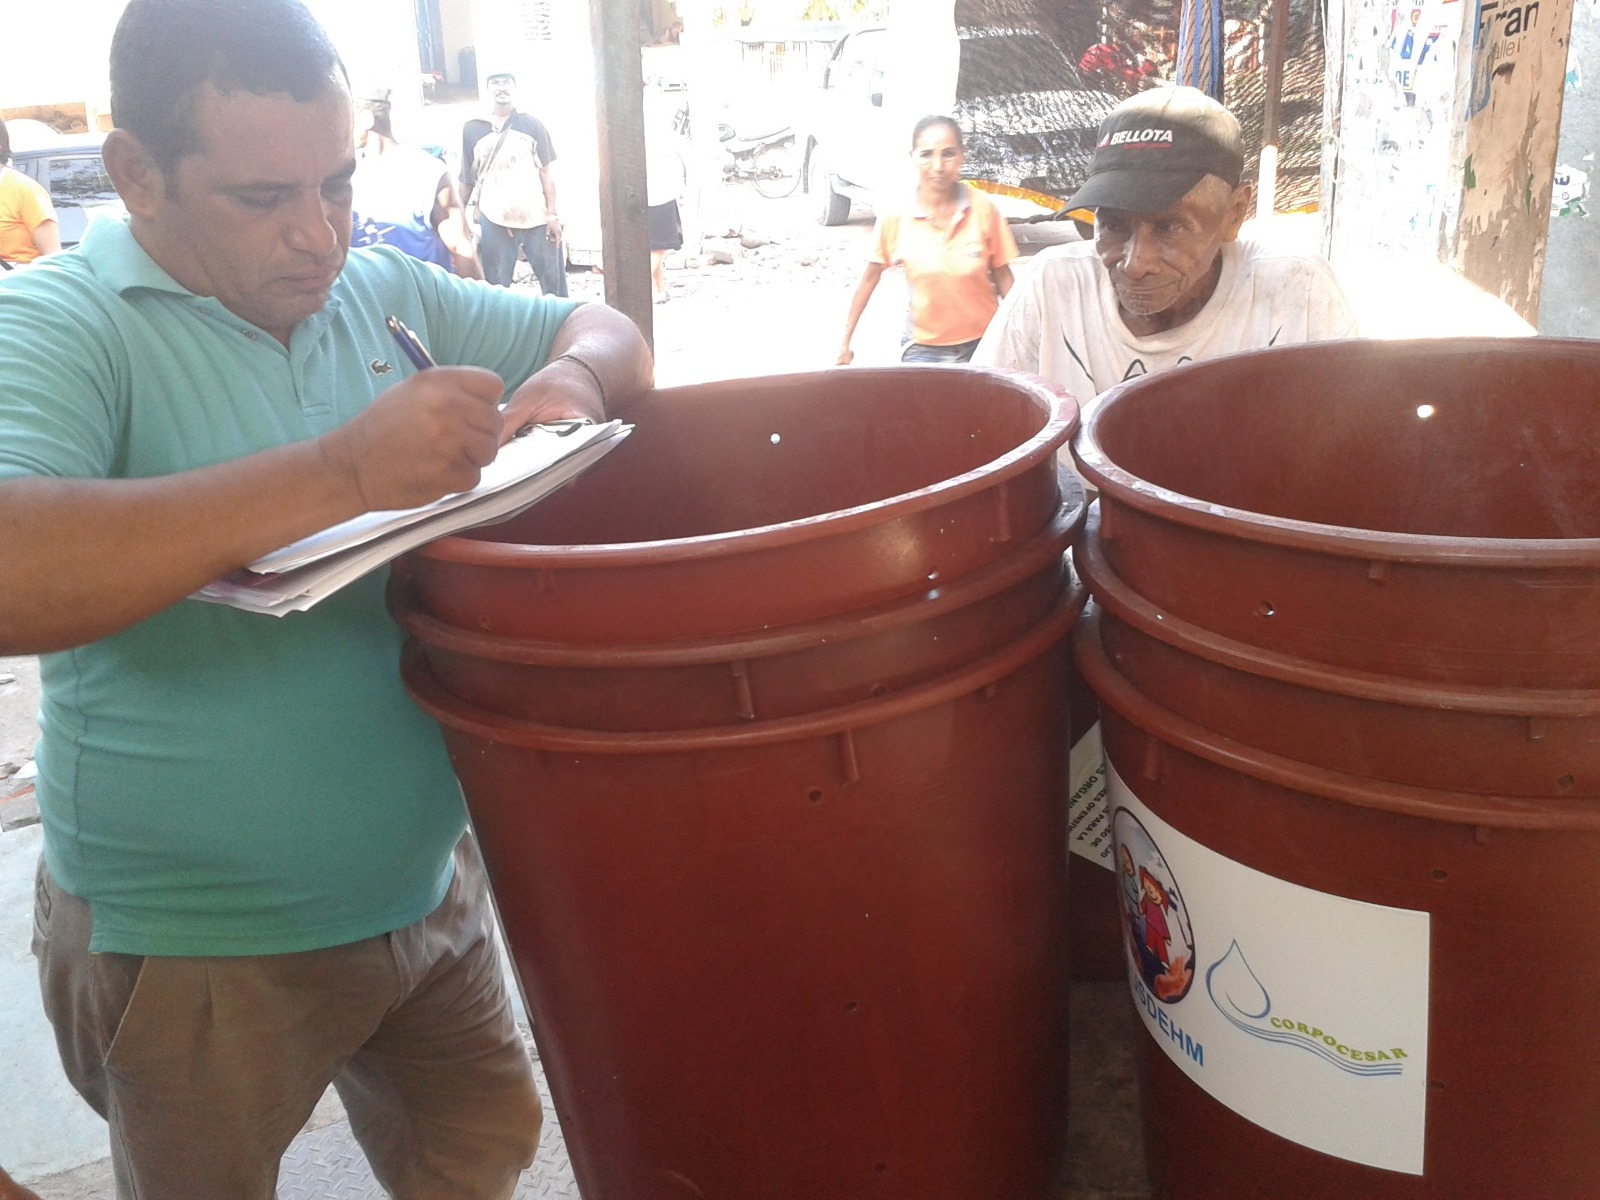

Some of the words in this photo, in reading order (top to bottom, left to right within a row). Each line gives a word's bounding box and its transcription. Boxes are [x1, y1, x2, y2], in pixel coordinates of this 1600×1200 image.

[1109, 128, 1173, 146] BELLOTA
[1069, 775, 1098, 809] ORGAN
[1069, 802, 1096, 833] OFENSIV
[1076, 831, 1089, 841] LA
[1270, 1016, 1409, 1062] CORPOCESAR
